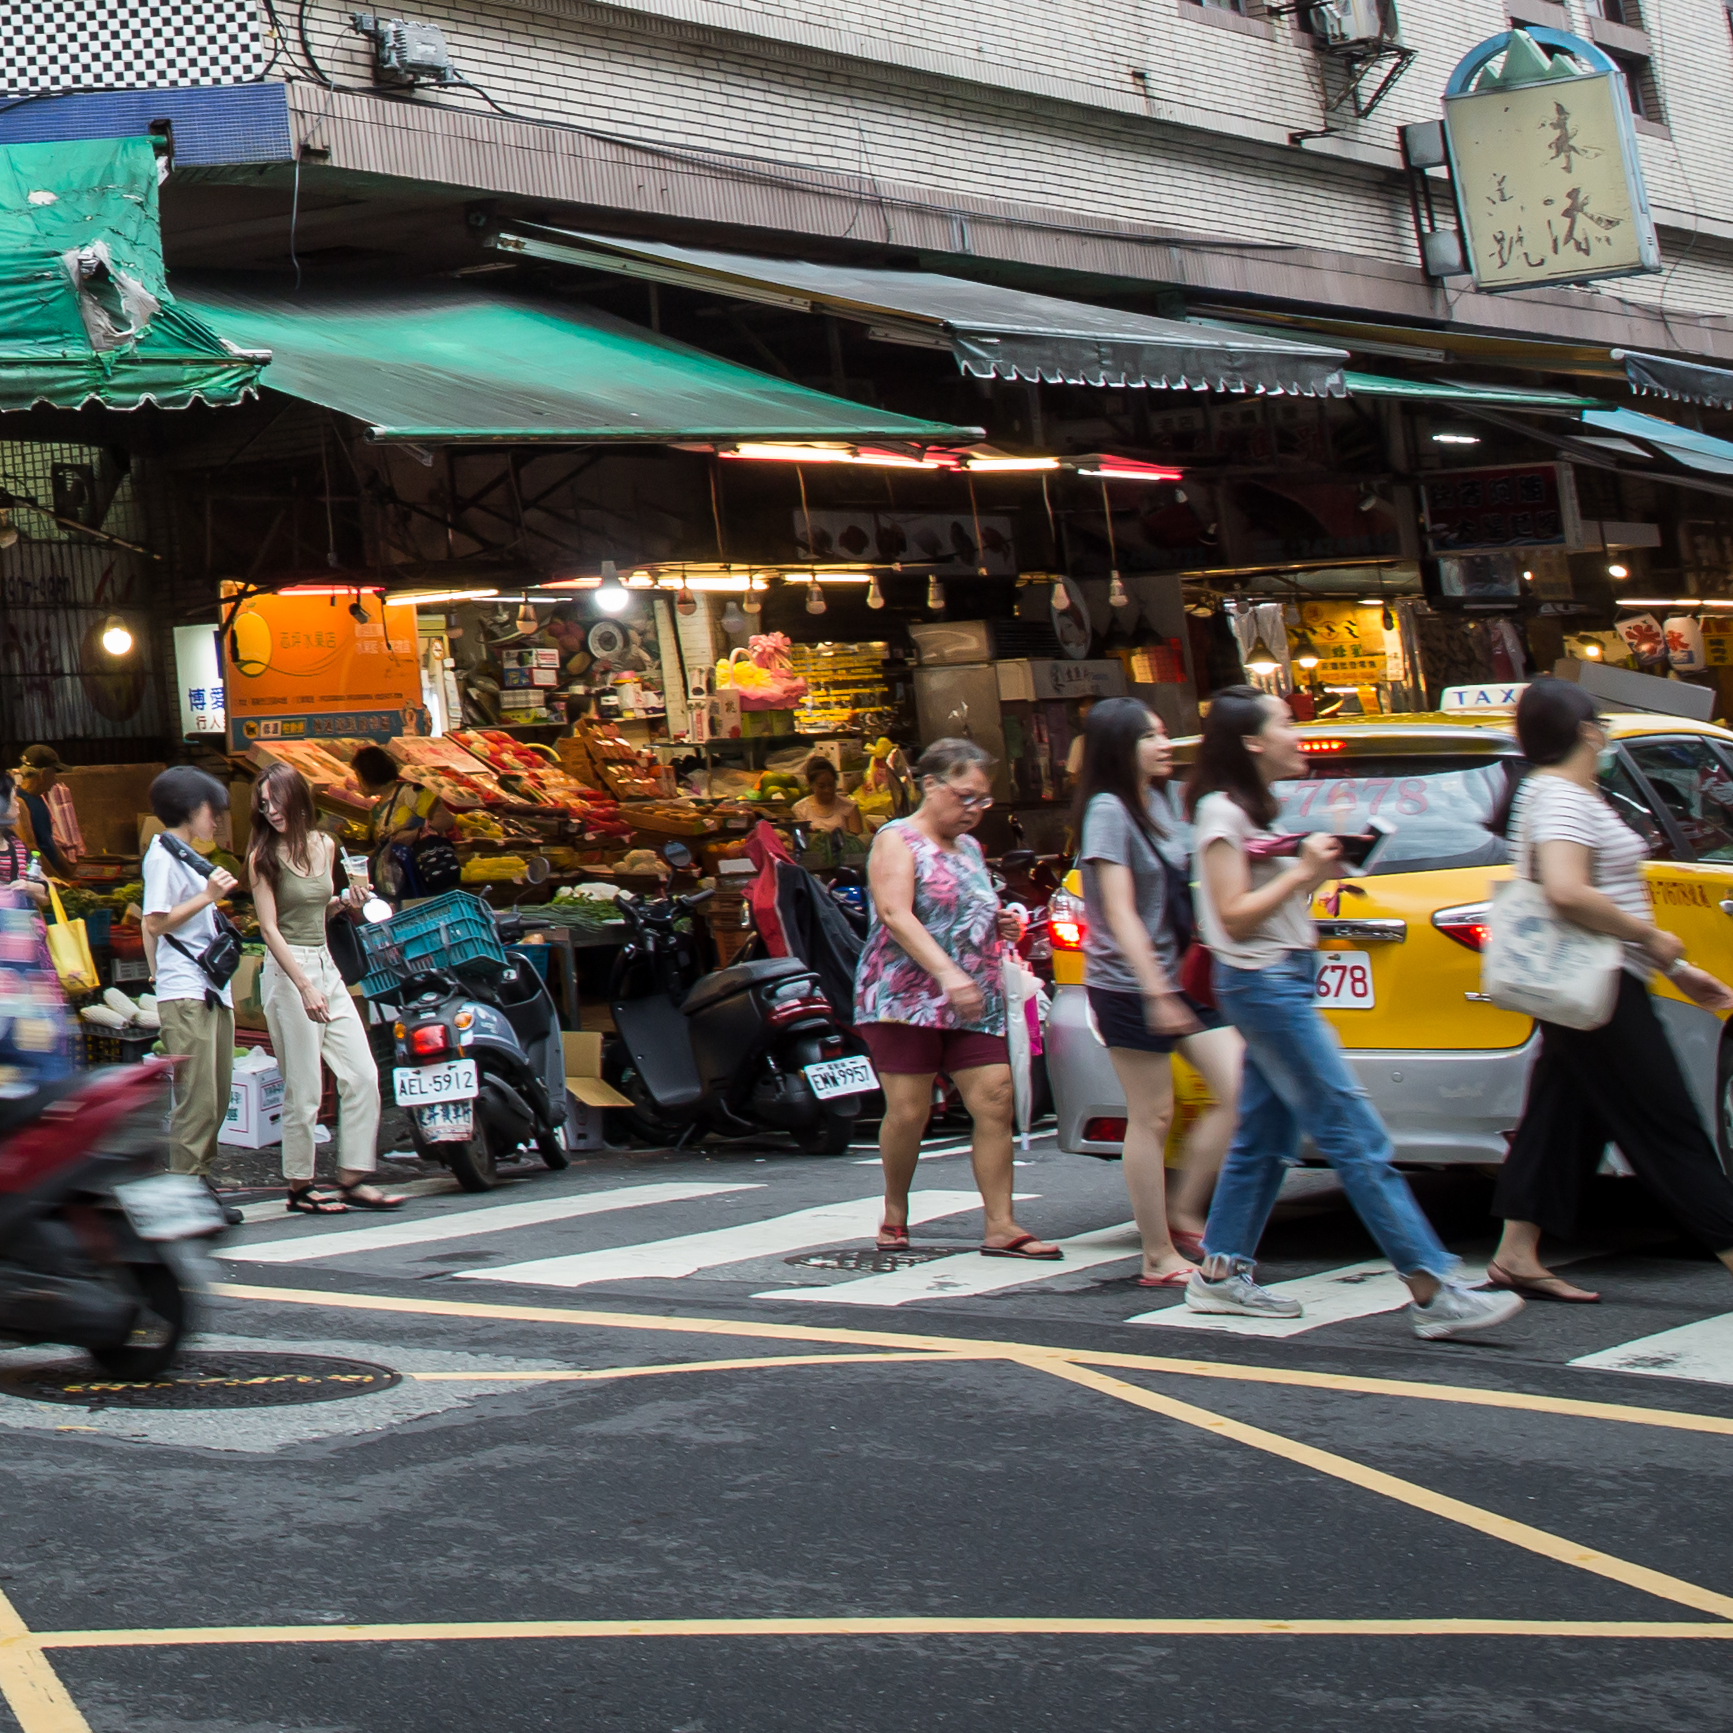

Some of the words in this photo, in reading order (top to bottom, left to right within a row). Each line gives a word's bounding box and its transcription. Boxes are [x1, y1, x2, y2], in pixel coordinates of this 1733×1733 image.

[1453, 689, 1516, 705] TAX
[195, 714, 227, 731] 行人
[1279, 778, 1429, 817] -7678
[1315, 964, 1369, 999] 678
[398, 1071, 474, 1096] AEL-5912
